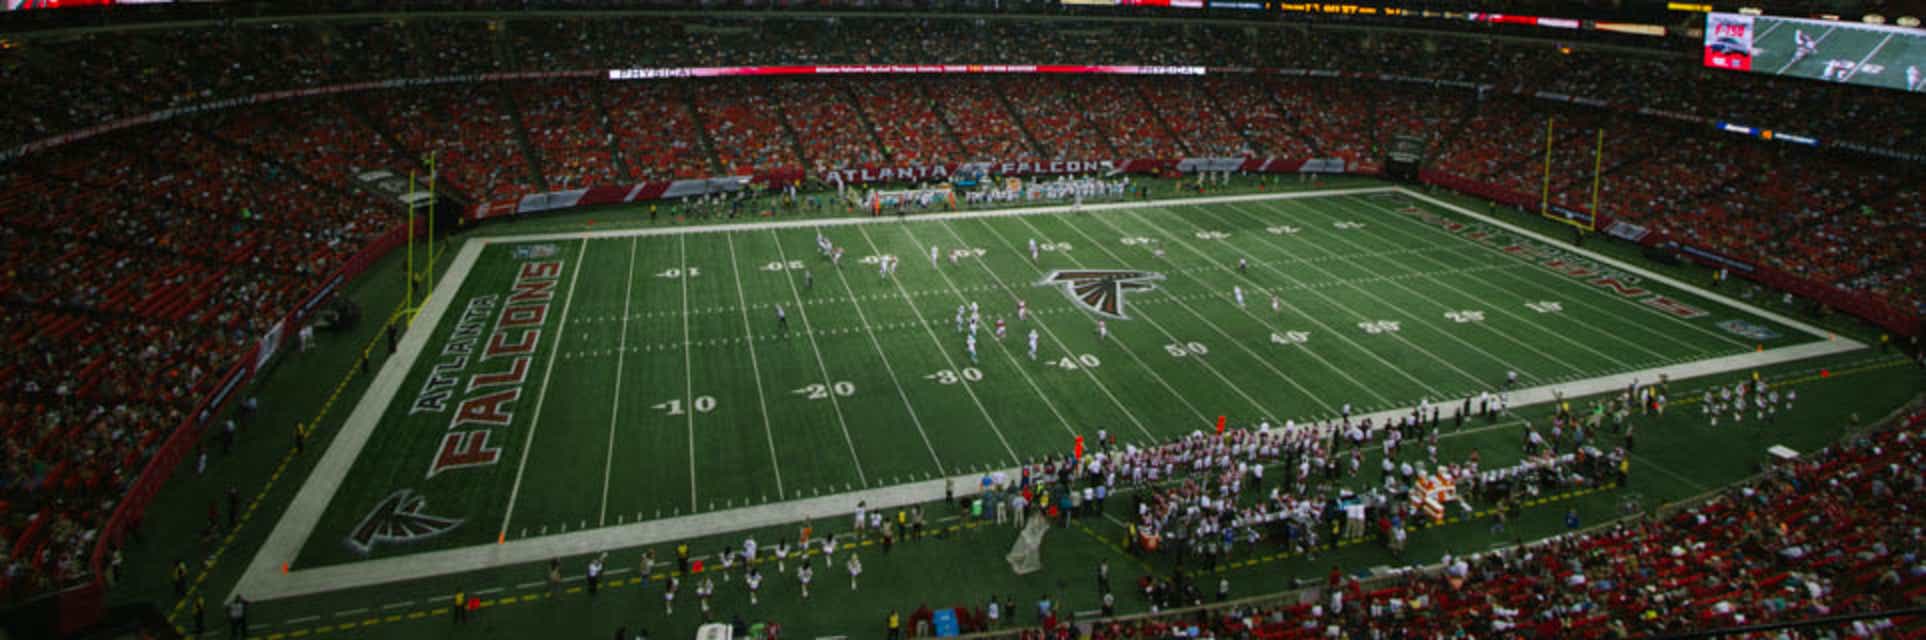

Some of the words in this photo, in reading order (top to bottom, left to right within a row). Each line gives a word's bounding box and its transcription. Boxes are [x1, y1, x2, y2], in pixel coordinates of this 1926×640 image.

[827, 164, 948, 182] ATLANTA
[409, 294, 499, 415] ATLANTA
[1164, 341, 1209, 357] 50
[426, 260, 565, 479] FALCONS
[1060, 354, 1100, 370] 40
[935, 368, 983, 385] 30
[805, 381, 855, 400] 20
[662, 396, 716, 415] 10
